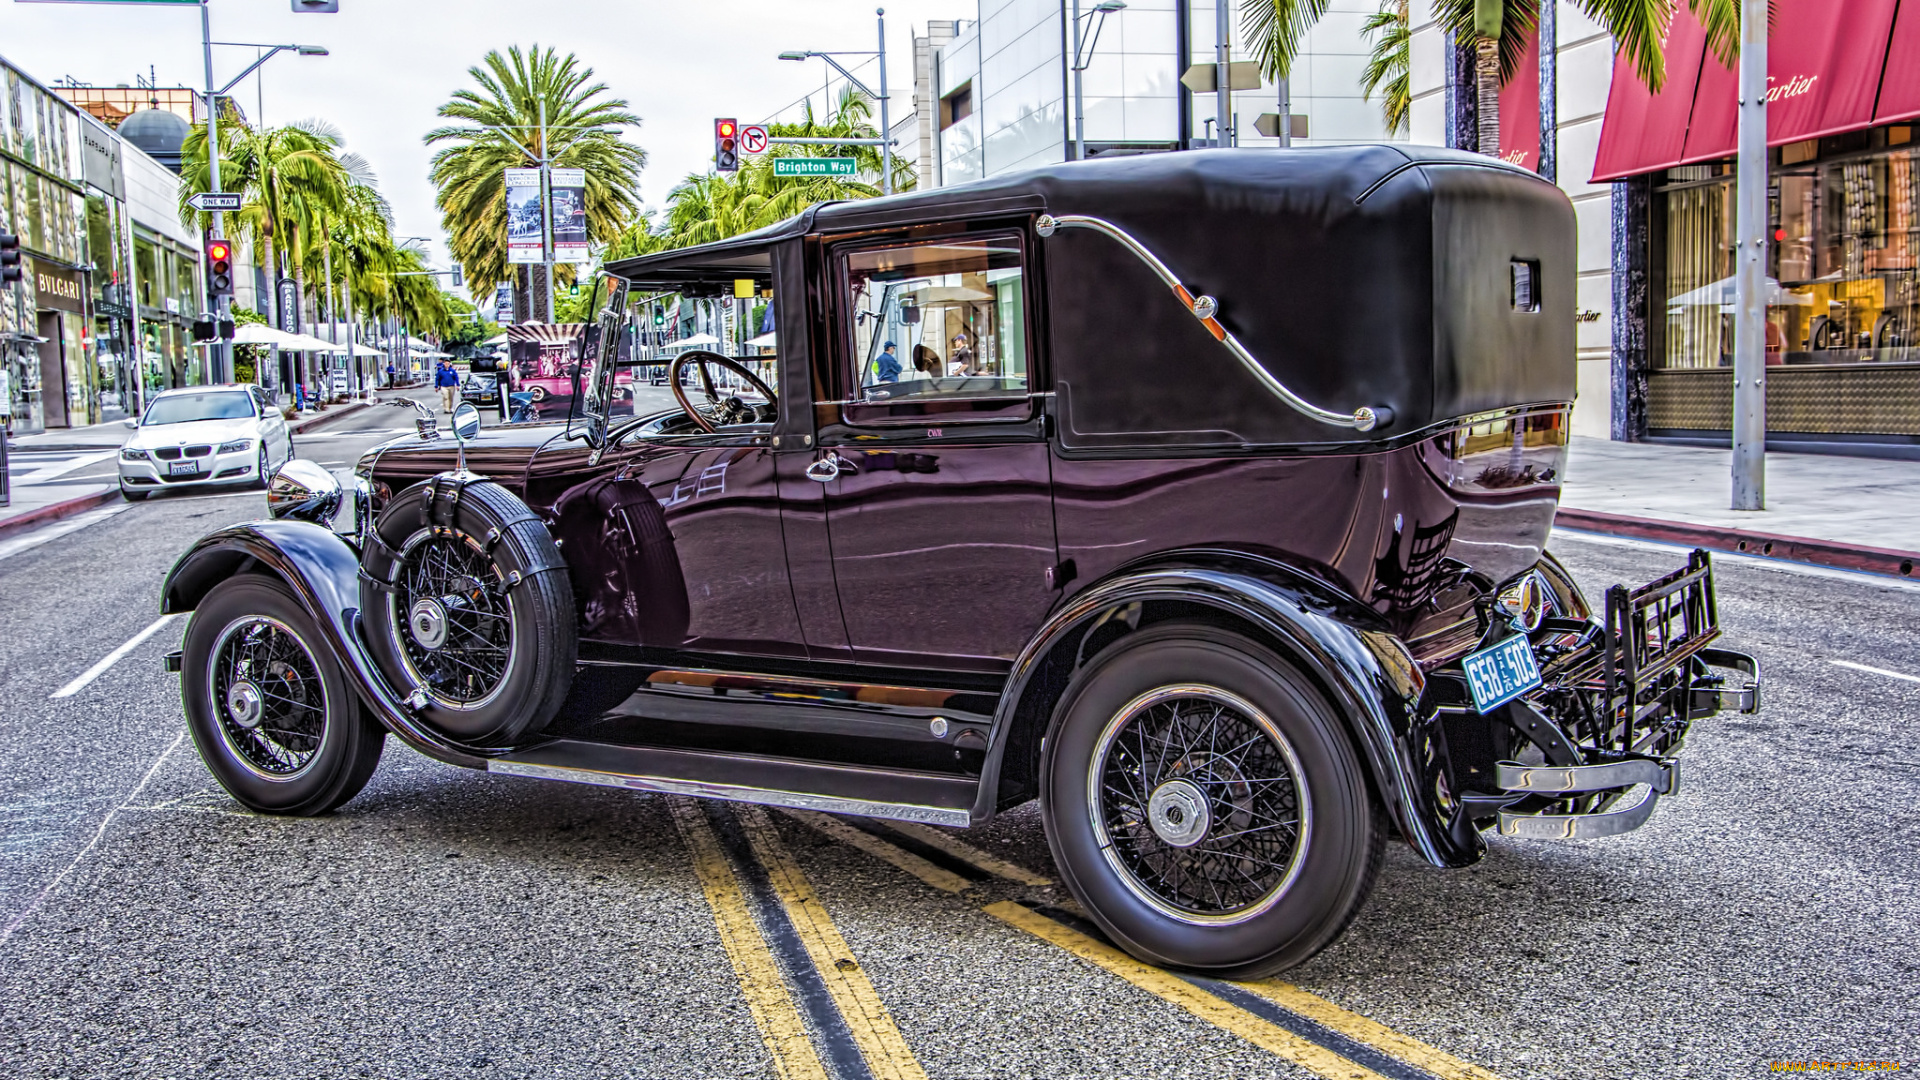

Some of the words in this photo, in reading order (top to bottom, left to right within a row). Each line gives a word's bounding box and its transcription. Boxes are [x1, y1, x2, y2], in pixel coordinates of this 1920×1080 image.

[1766, 75, 1818, 102] artier
[778, 162, 826, 174] Brighton
[830, 162, 852, 174] Way
[39, 273, 80, 300] BVLGARI
[1576, 307, 1601, 322] artier
[1468, 655, 1504, 705] 658
[1503, 640, 1537, 688] 503
